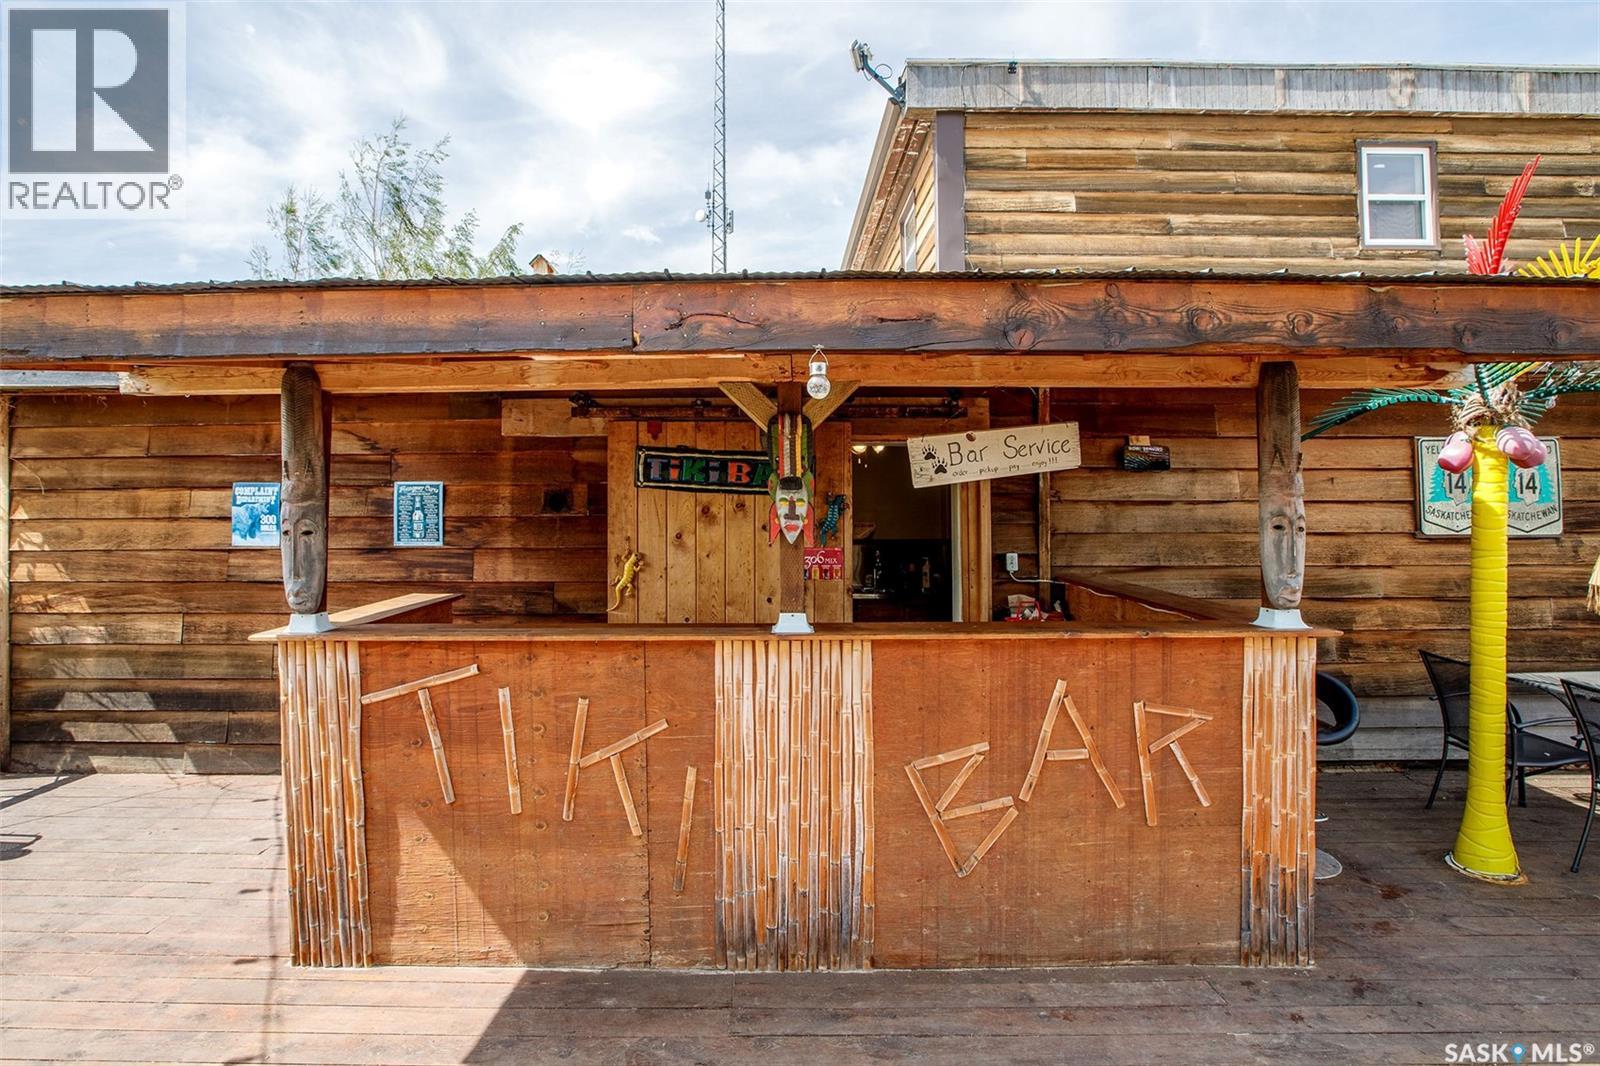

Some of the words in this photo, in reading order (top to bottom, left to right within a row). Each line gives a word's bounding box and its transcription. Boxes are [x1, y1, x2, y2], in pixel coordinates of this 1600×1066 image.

[947, 441, 988, 466] Bar
[1002, 434, 1071, 460] Service
[728, 461, 772, 486] BA
[1446, 471, 1467, 494] 14
[1517, 471, 1538, 495] 14
[234, 486, 279, 496] COMPLAINT
[260, 514, 277, 525] 300
[1425, 505, 1472, 521] SASKATCHE
[804, 550, 825, 569] 306
[361, 663, 697, 893] TIKI
[904, 678, 1214, 878] BAR
